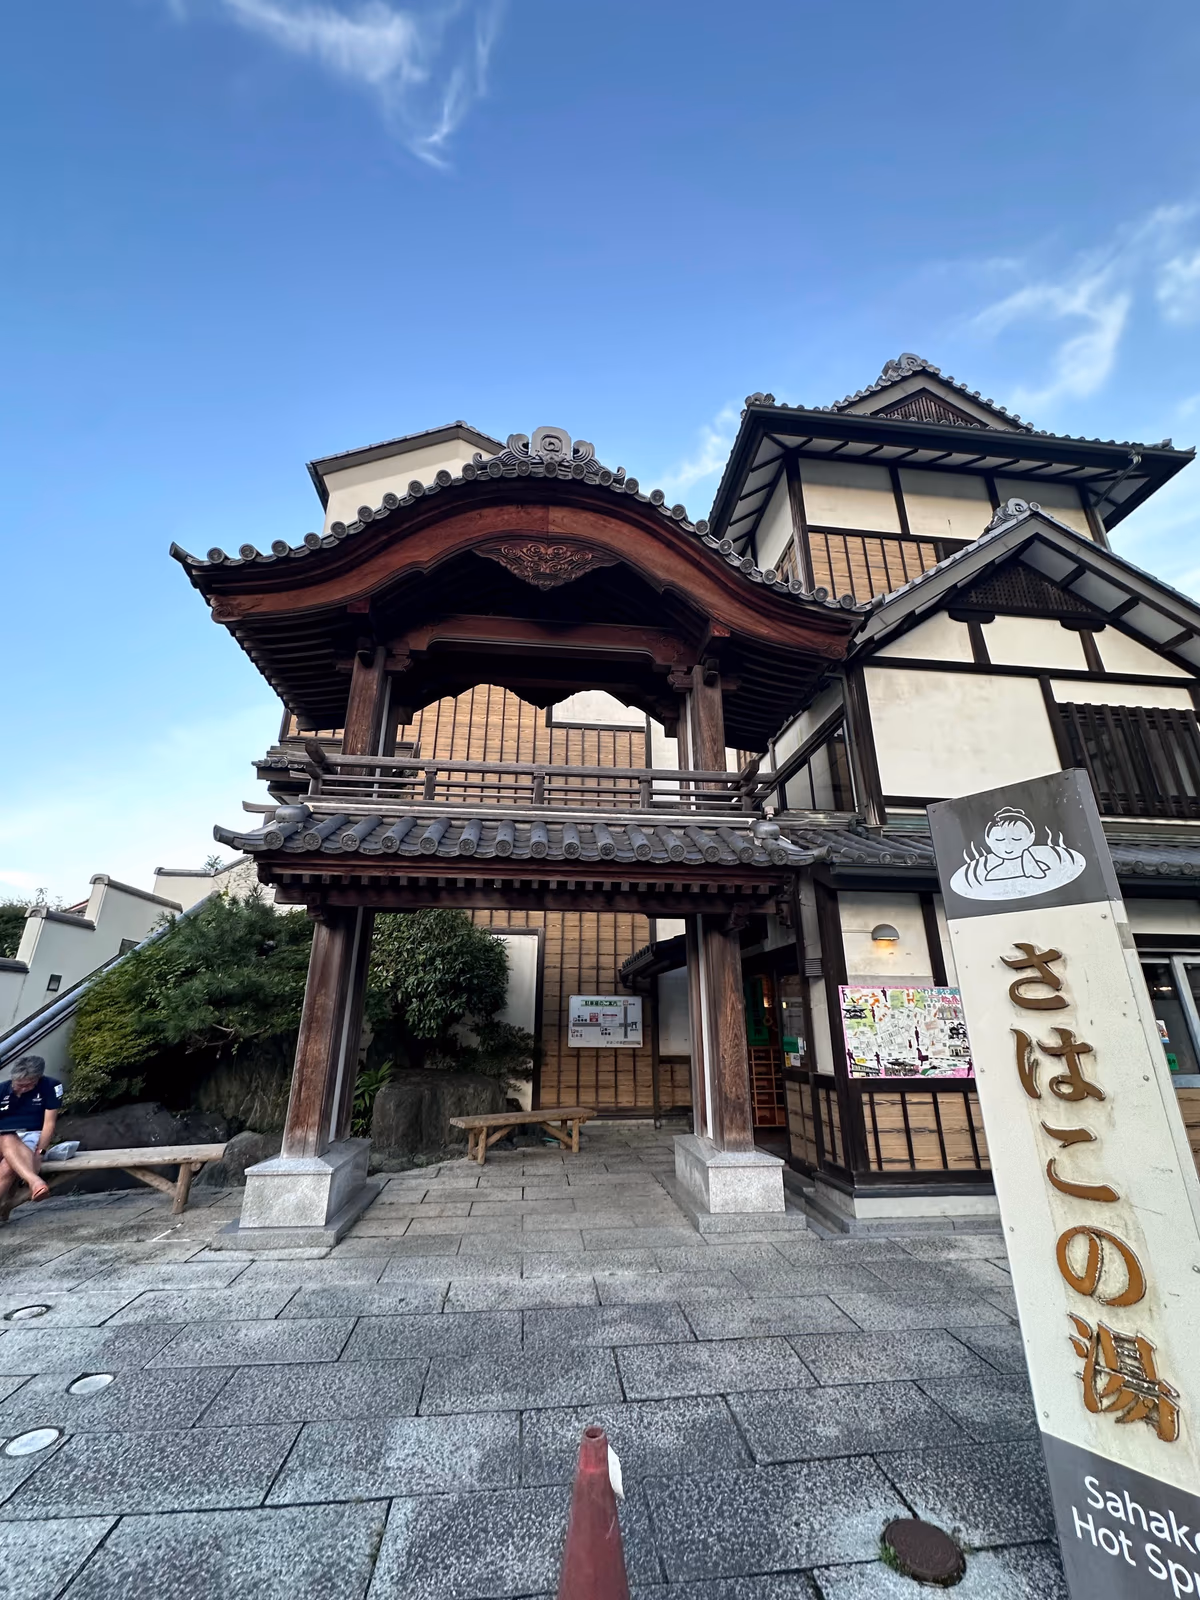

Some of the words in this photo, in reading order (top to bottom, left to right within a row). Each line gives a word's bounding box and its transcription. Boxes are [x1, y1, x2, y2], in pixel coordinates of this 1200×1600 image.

[999, 942, 1181, 1443] さはこの湯
[1071, 1505, 1137, 1567] Hot
[1084, 1475, 1200, 1555] Sahak
